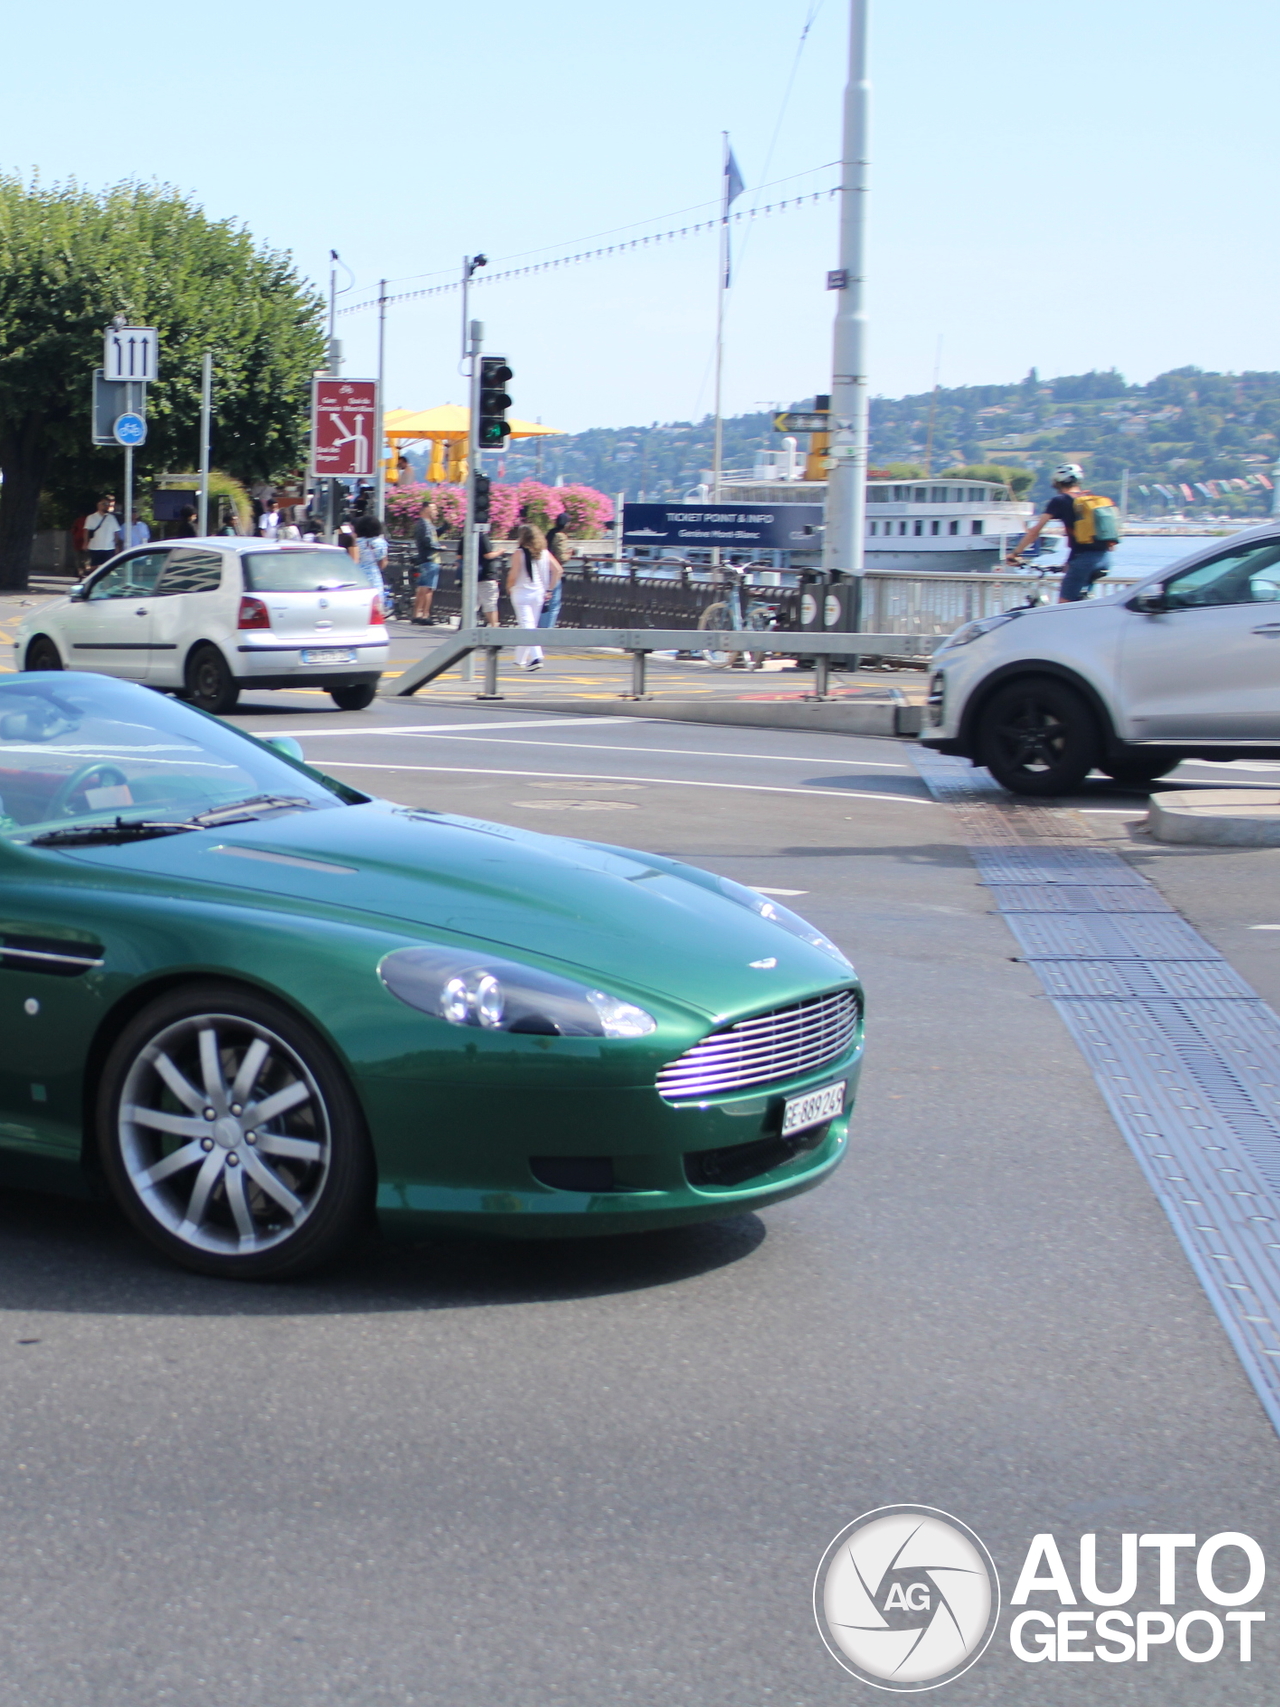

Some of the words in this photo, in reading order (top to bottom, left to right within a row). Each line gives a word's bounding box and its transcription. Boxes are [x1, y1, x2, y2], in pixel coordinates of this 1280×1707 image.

[665, 512, 703, 522] TICKET
[704, 512, 736, 523] POINT
[737, 513, 745, 523] &
[746, 514, 775, 524] INFO
